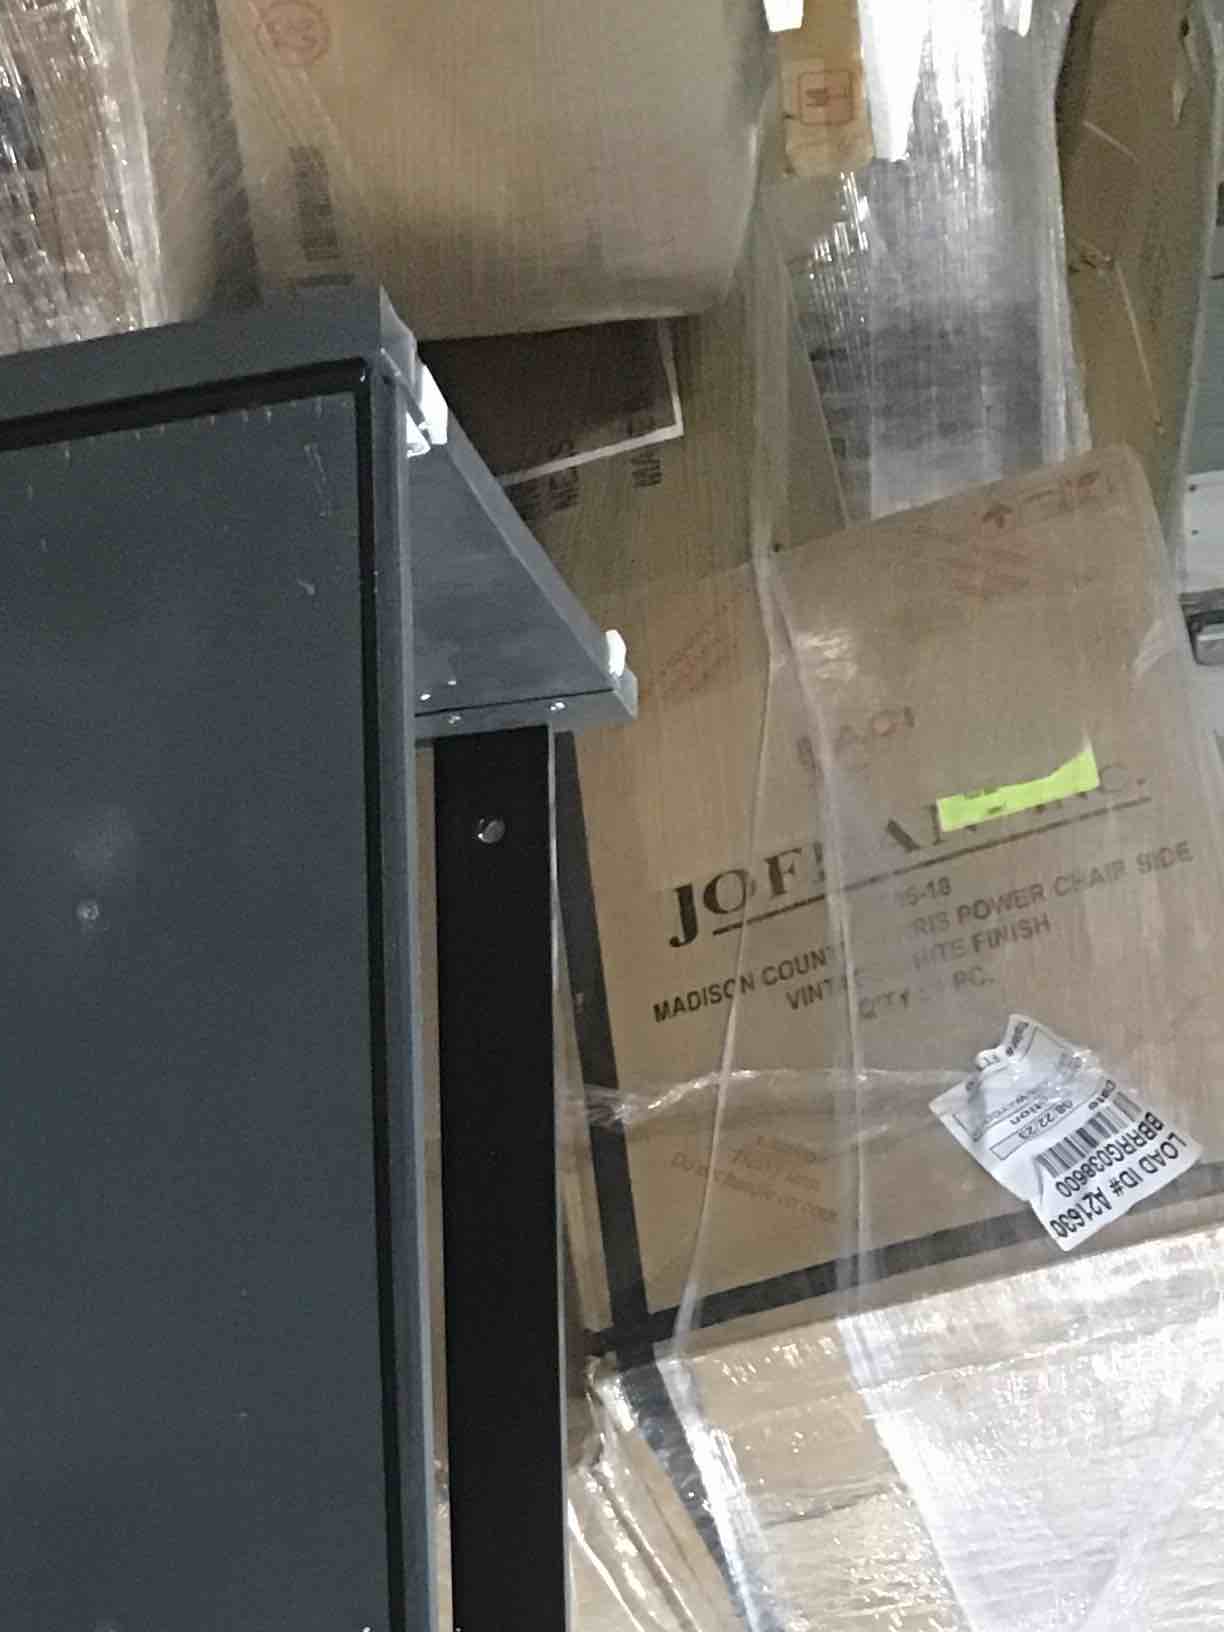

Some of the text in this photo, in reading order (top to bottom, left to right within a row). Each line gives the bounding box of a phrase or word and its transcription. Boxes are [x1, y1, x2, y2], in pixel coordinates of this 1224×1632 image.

[652, 974, 756, 1023] MADISON
[957, 882, 1046, 926] POWER
[1135, 839, 1194, 875] SIDE
[970, 911, 1051, 954] FINISH
[1049, 1131, 1188, 1239] LOAD ID# A21630
[1055, 1111, 1165, 1198] BBRRG038600
